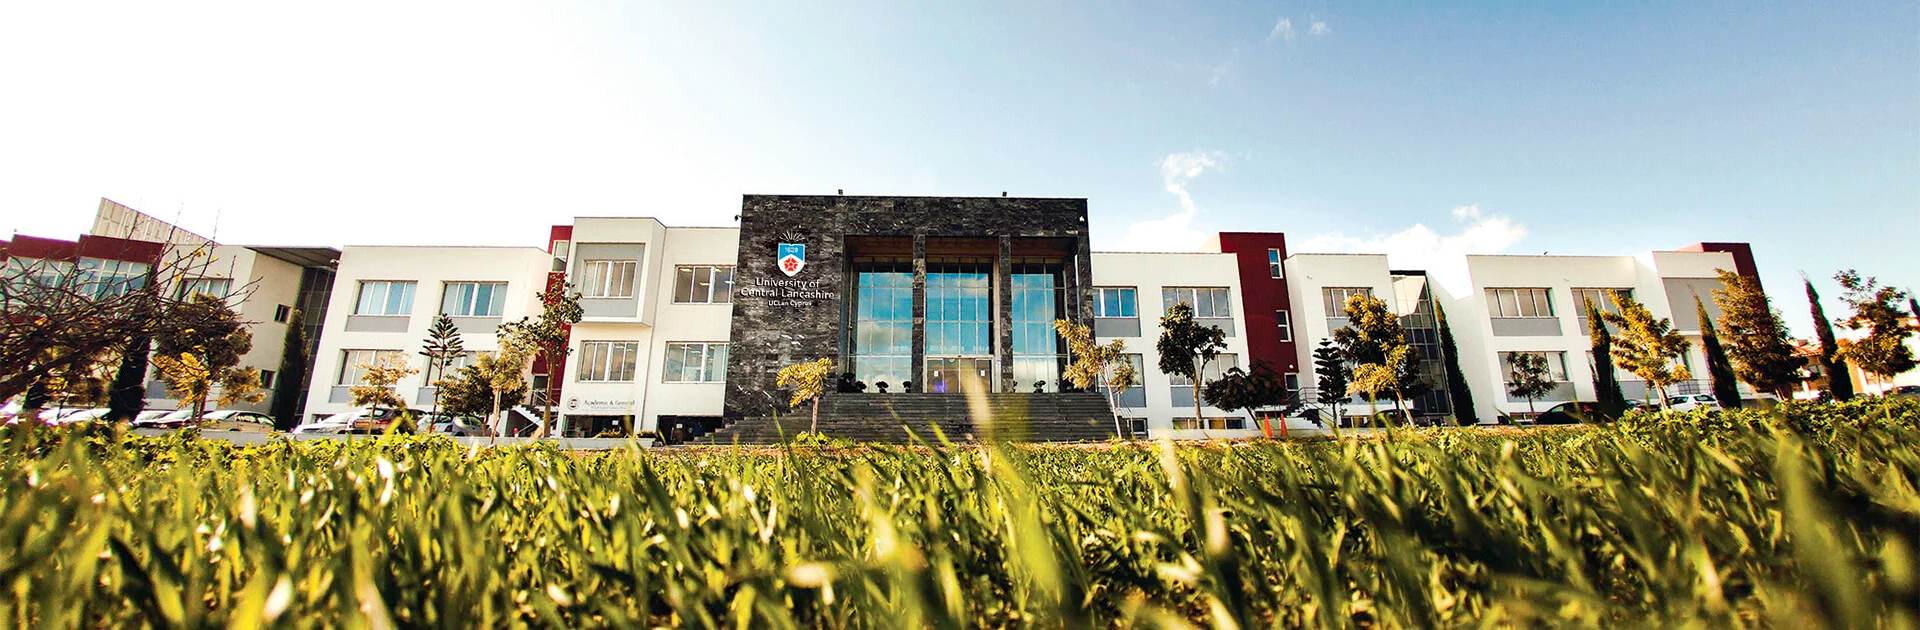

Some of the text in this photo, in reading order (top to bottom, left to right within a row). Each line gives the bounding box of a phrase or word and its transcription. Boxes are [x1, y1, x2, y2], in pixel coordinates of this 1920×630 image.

[756, 278, 820, 290] University of
[740, 288, 835, 299] Central Lancashire
